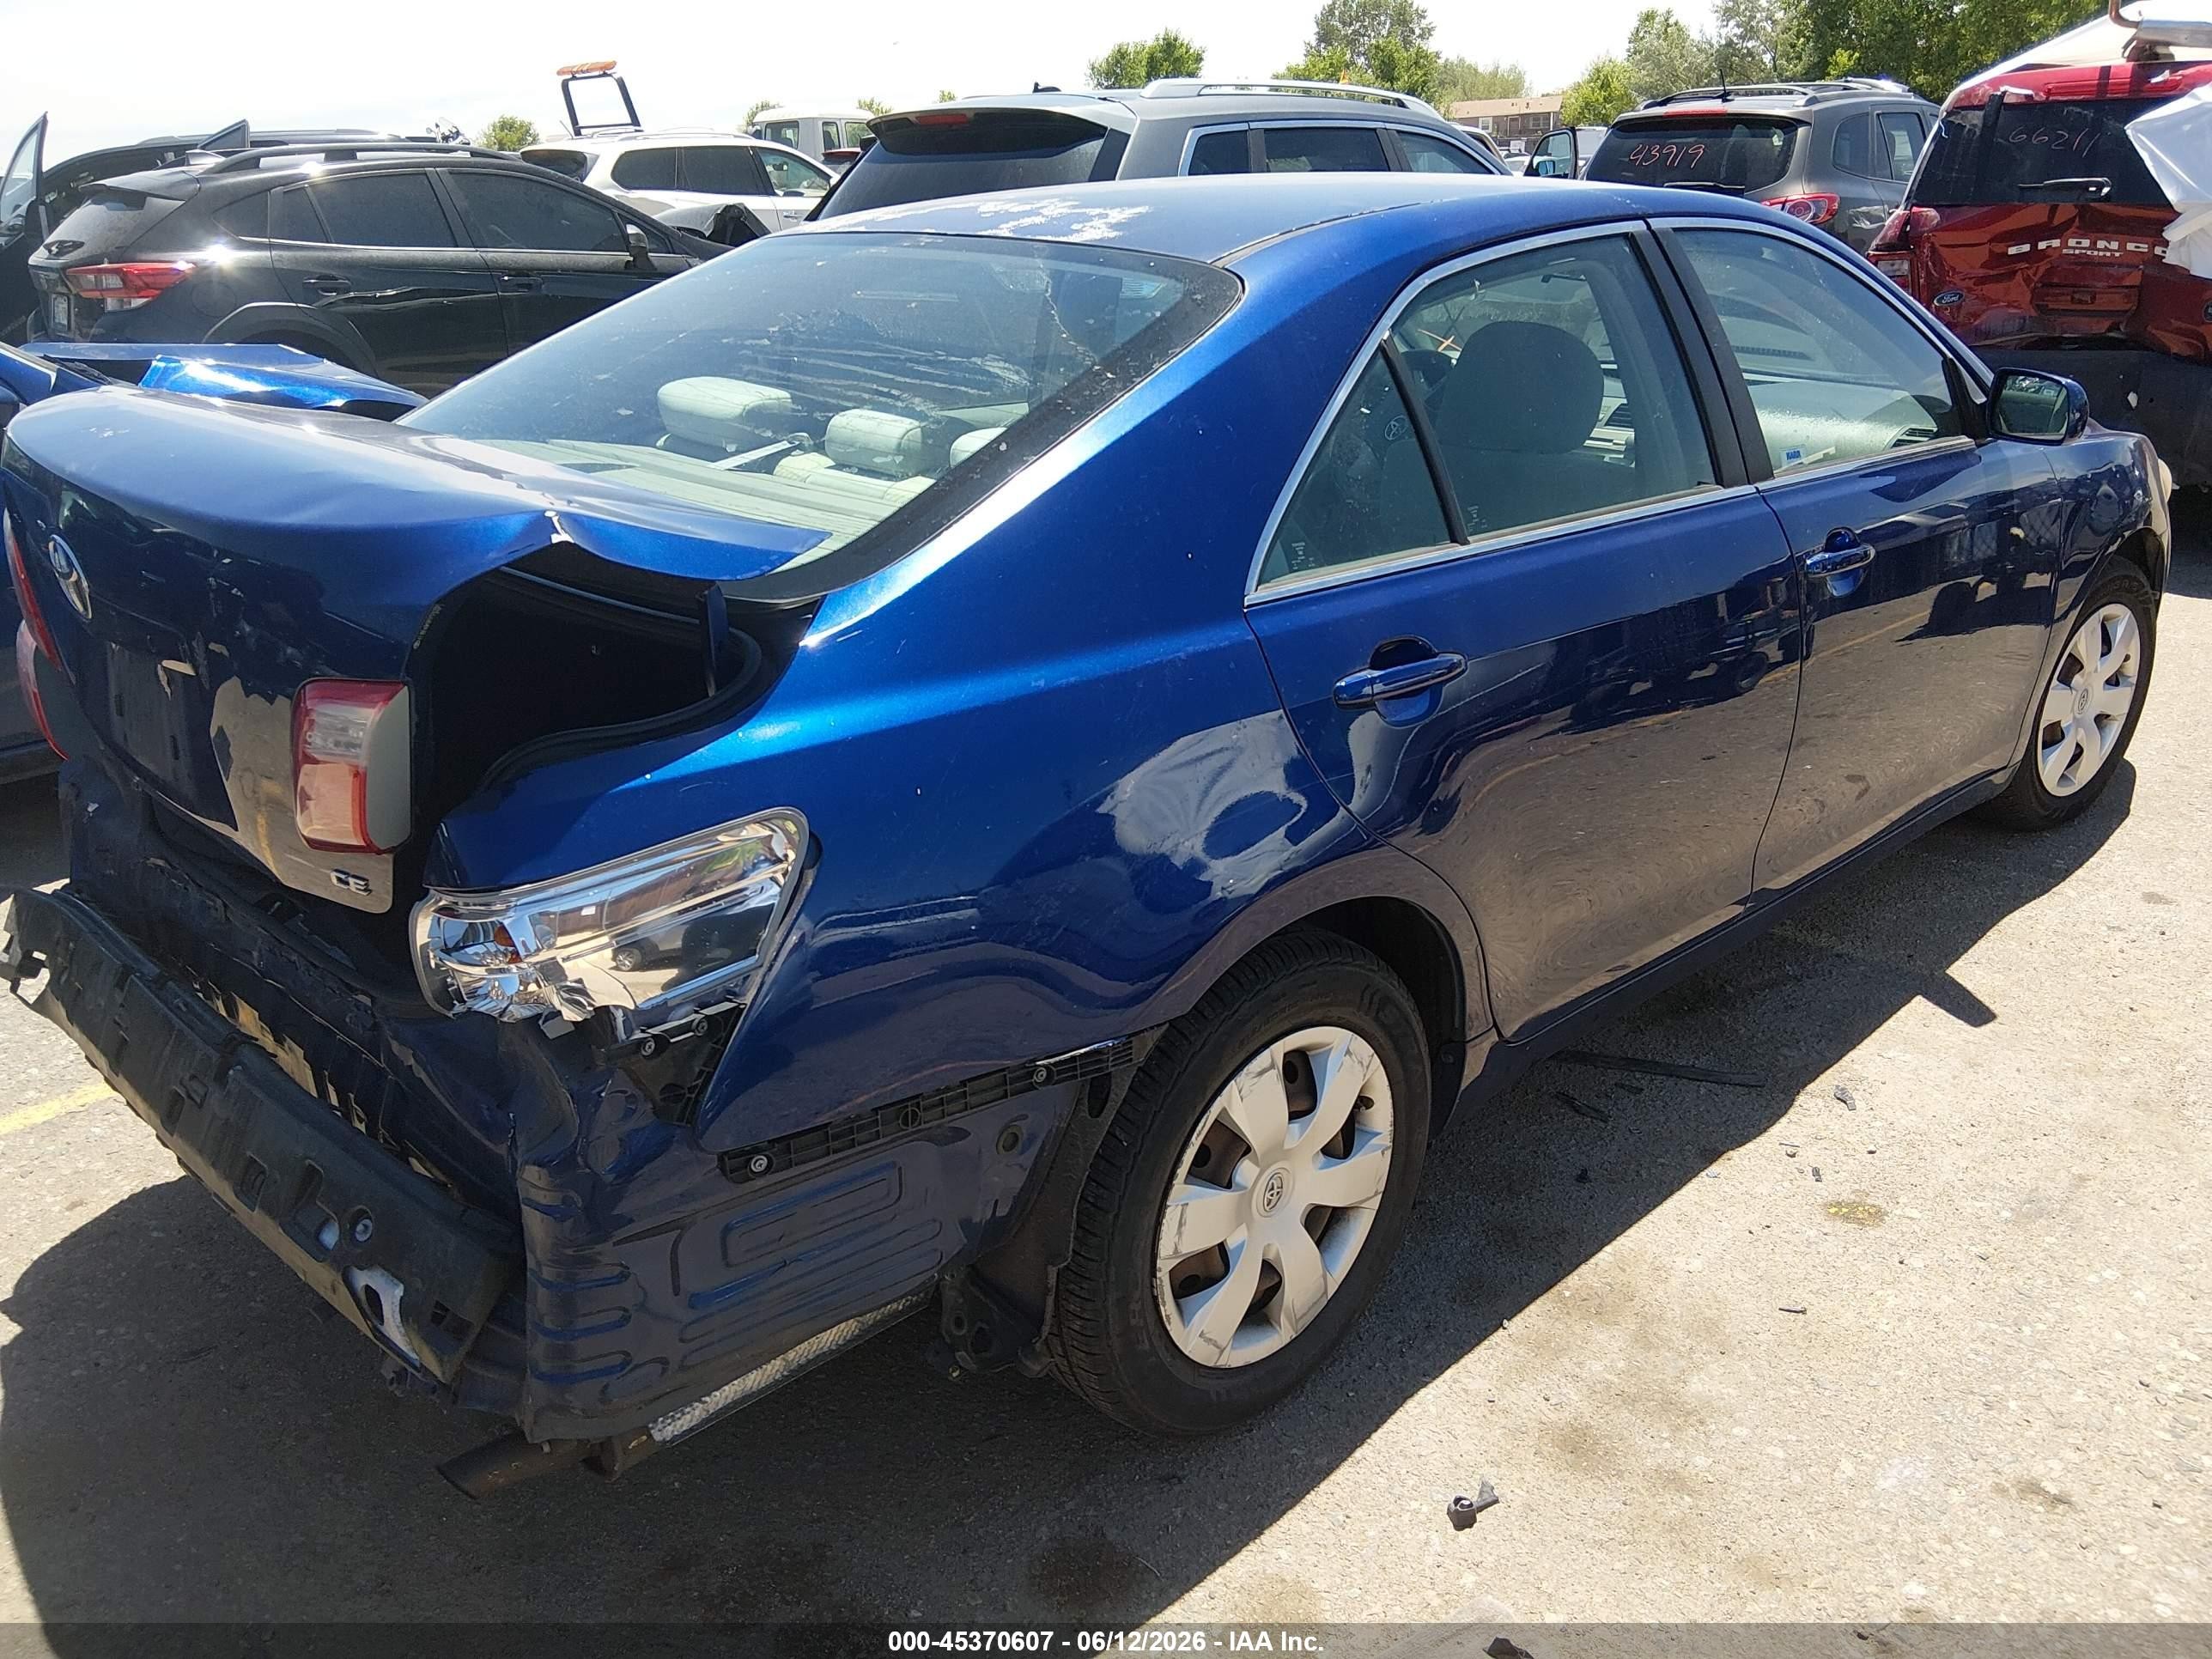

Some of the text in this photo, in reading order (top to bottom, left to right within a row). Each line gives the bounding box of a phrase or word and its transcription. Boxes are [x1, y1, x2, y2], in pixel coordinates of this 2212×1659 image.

[2008, 125, 2101, 158] 66211
[1628, 143, 1705, 169] 43919
[2062, 248, 2124, 258] SPORT
